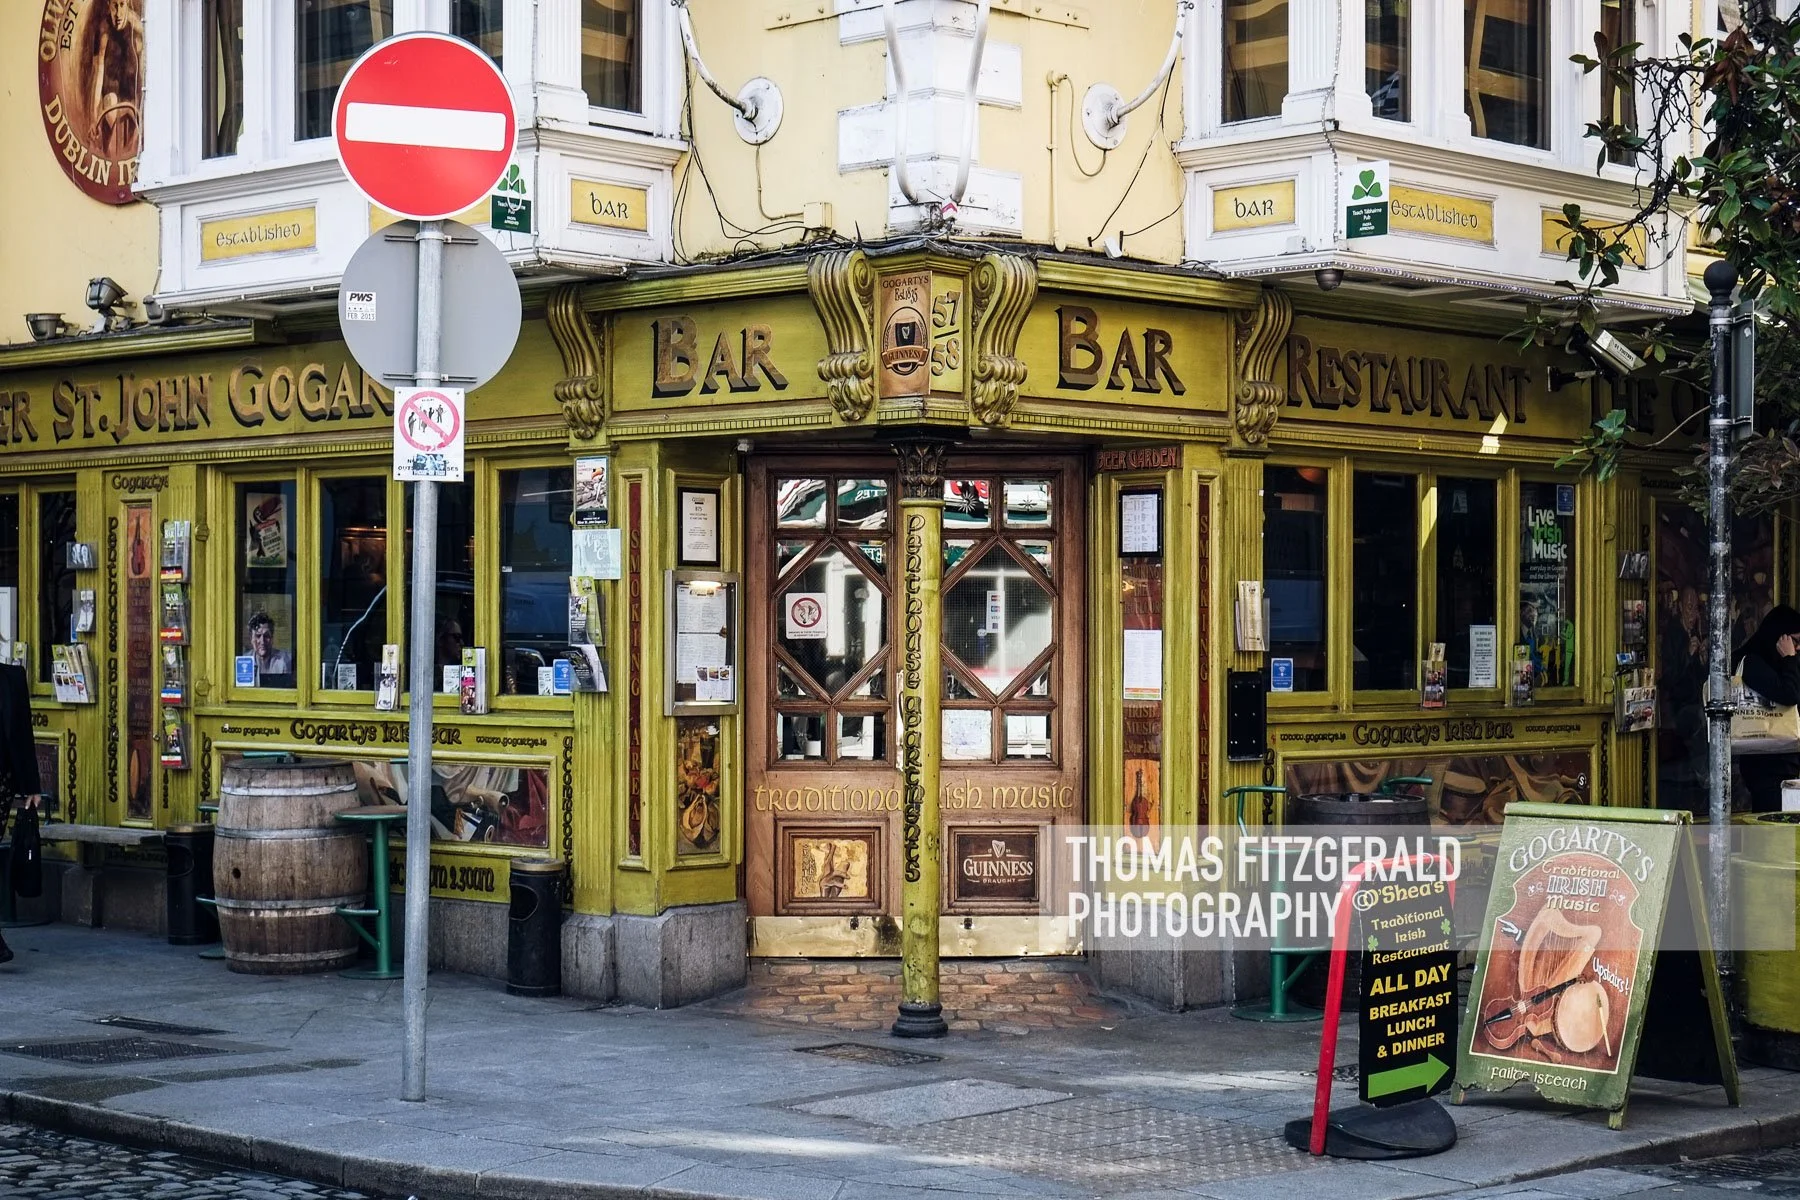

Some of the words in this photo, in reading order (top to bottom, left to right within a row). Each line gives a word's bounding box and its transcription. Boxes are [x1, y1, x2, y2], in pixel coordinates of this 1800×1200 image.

[45, 94, 112, 186] DUBLIN
[1391, 199, 1479, 230] established
[215, 222, 301, 248] established
[883, 275, 929, 289] GOGARTYS
[349, 293, 374, 302] PWS
[932, 290, 961, 329] 57
[651, 314, 790, 398] BAR
[931, 337, 961, 377] 58
[1054, 304, 1188, 396] BAR
[1286, 333, 1532, 424] RESTAURANT
[1097, 450, 1127, 471] BEER
[1128, 446, 1177, 469] GARDEN
[1528, 506, 1555, 529] Live
[1533, 522, 1562, 543] Irish
[1532, 539, 1567, 562] Music
[906, 514, 926, 690] penthouse
[1200, 515, 1208, 681] SMOKING
[630, 529, 640, 697] SMOKING
[1757, 709, 1783, 718] STORES
[290, 718, 377, 745] Gogartys
[1353, 720, 1440, 747] Gogartys
[1444, 720, 1483, 742] Irish
[1200, 713, 1208, 805] AREA
[630, 729, 640, 821] AREA
[905, 695, 926, 883] apartments
[753, 783, 902, 812] traditiona
[991, 781, 1074, 810] music
[963, 858, 1033, 877] GUINNESS
[1509, 825, 1655, 883] GOGARTY'S
[1541, 858, 1621, 880] Traditional
[1362, 880, 1445, 908] O'Shea's
[1546, 874, 1608, 897] IRISH
[1546, 895, 1601, 913] Music
[1371, 906, 1445, 931] Traditional
[1395, 927, 1426, 944] Irish
[1372, 939, 1450, 965] Restaurant
[1369, 973, 1409, 997] ALL
[1415, 962, 1452, 988] DAY
[1592, 956, 1630, 996] Upstairs!
[1369, 991, 1452, 1021] BREAKFAST
[1386, 1014, 1436, 1037] LUNCH
[1377, 1044, 1388, 1059] &
[1392, 1031, 1445, 1057] DINNER
